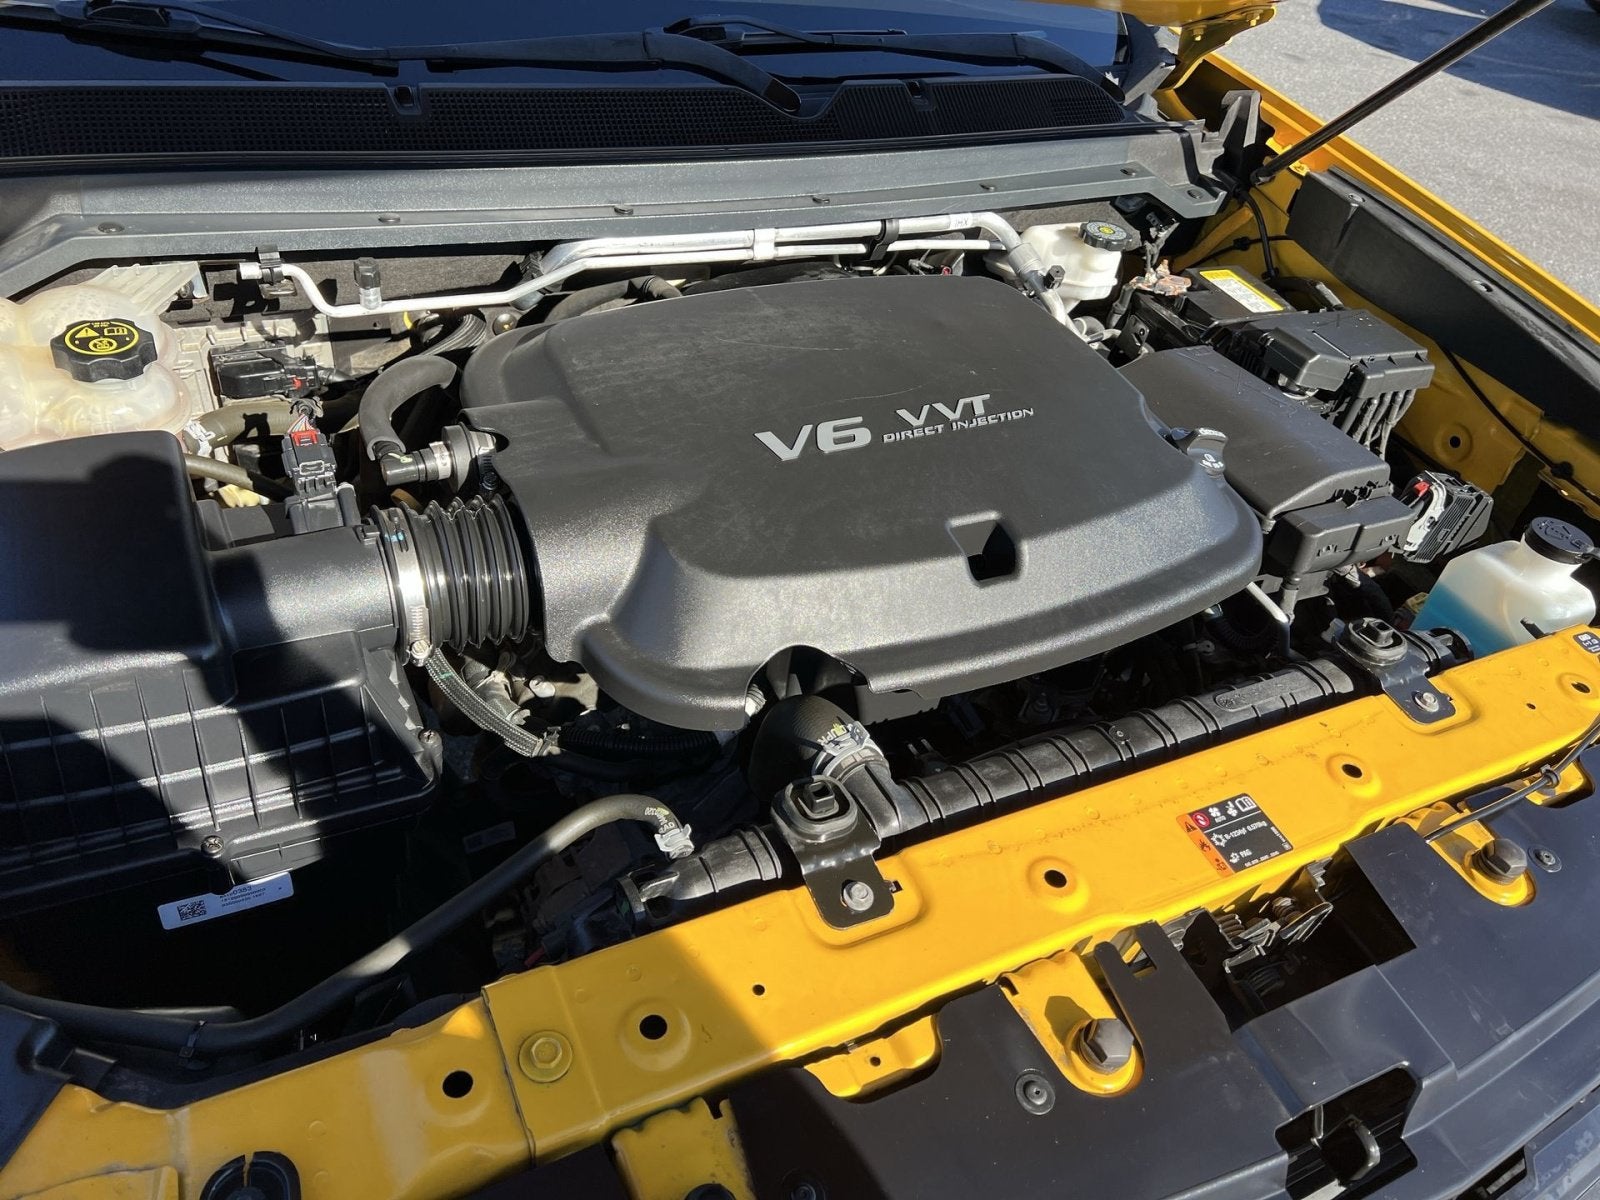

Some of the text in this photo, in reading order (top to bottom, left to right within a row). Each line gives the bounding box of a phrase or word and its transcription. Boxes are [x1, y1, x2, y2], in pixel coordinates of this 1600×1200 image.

[882, 408, 1034, 443] DIRECT INJECTION
[896, 393, 990, 427] VVT
[754, 416, 872, 461] V6
[1239, 848, 1253, 858] PAG
